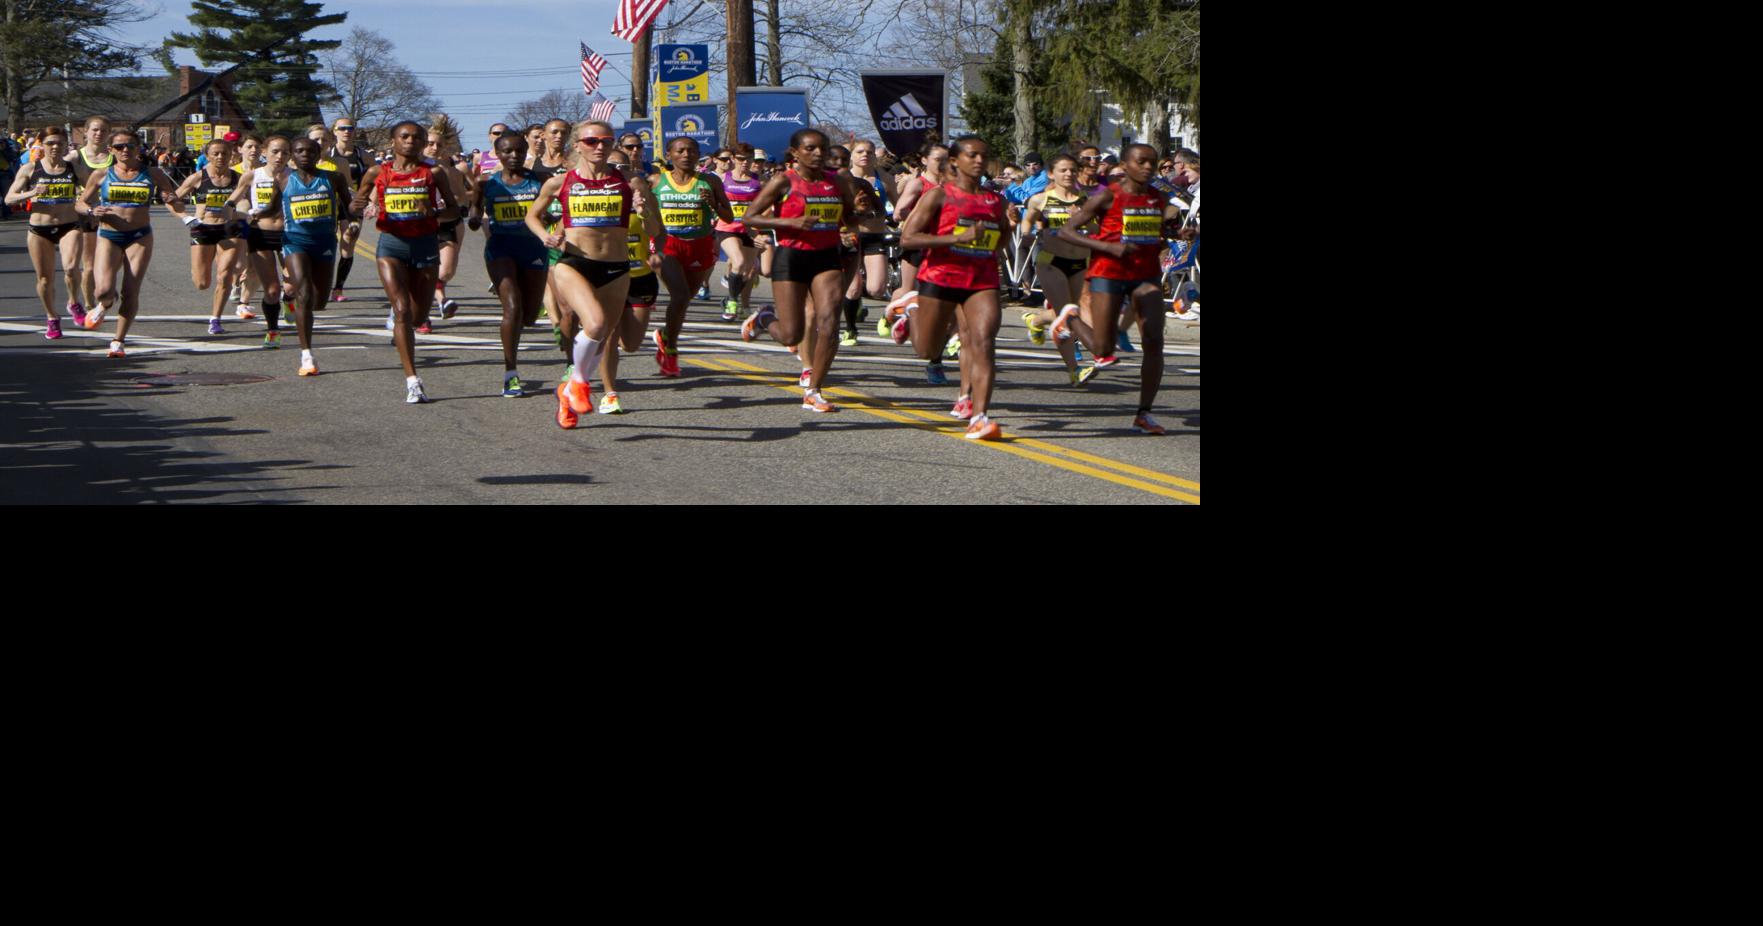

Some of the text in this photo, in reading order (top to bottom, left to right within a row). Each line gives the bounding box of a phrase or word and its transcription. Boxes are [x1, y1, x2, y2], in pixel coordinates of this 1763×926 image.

[741, 111, 804, 129] John Hancock
[880, 117, 937, 130] adidas
[111, 190, 148, 201] THOMAS
[295, 204, 328, 217] CHEROP
[573, 202, 619, 212] FLANAGAN
